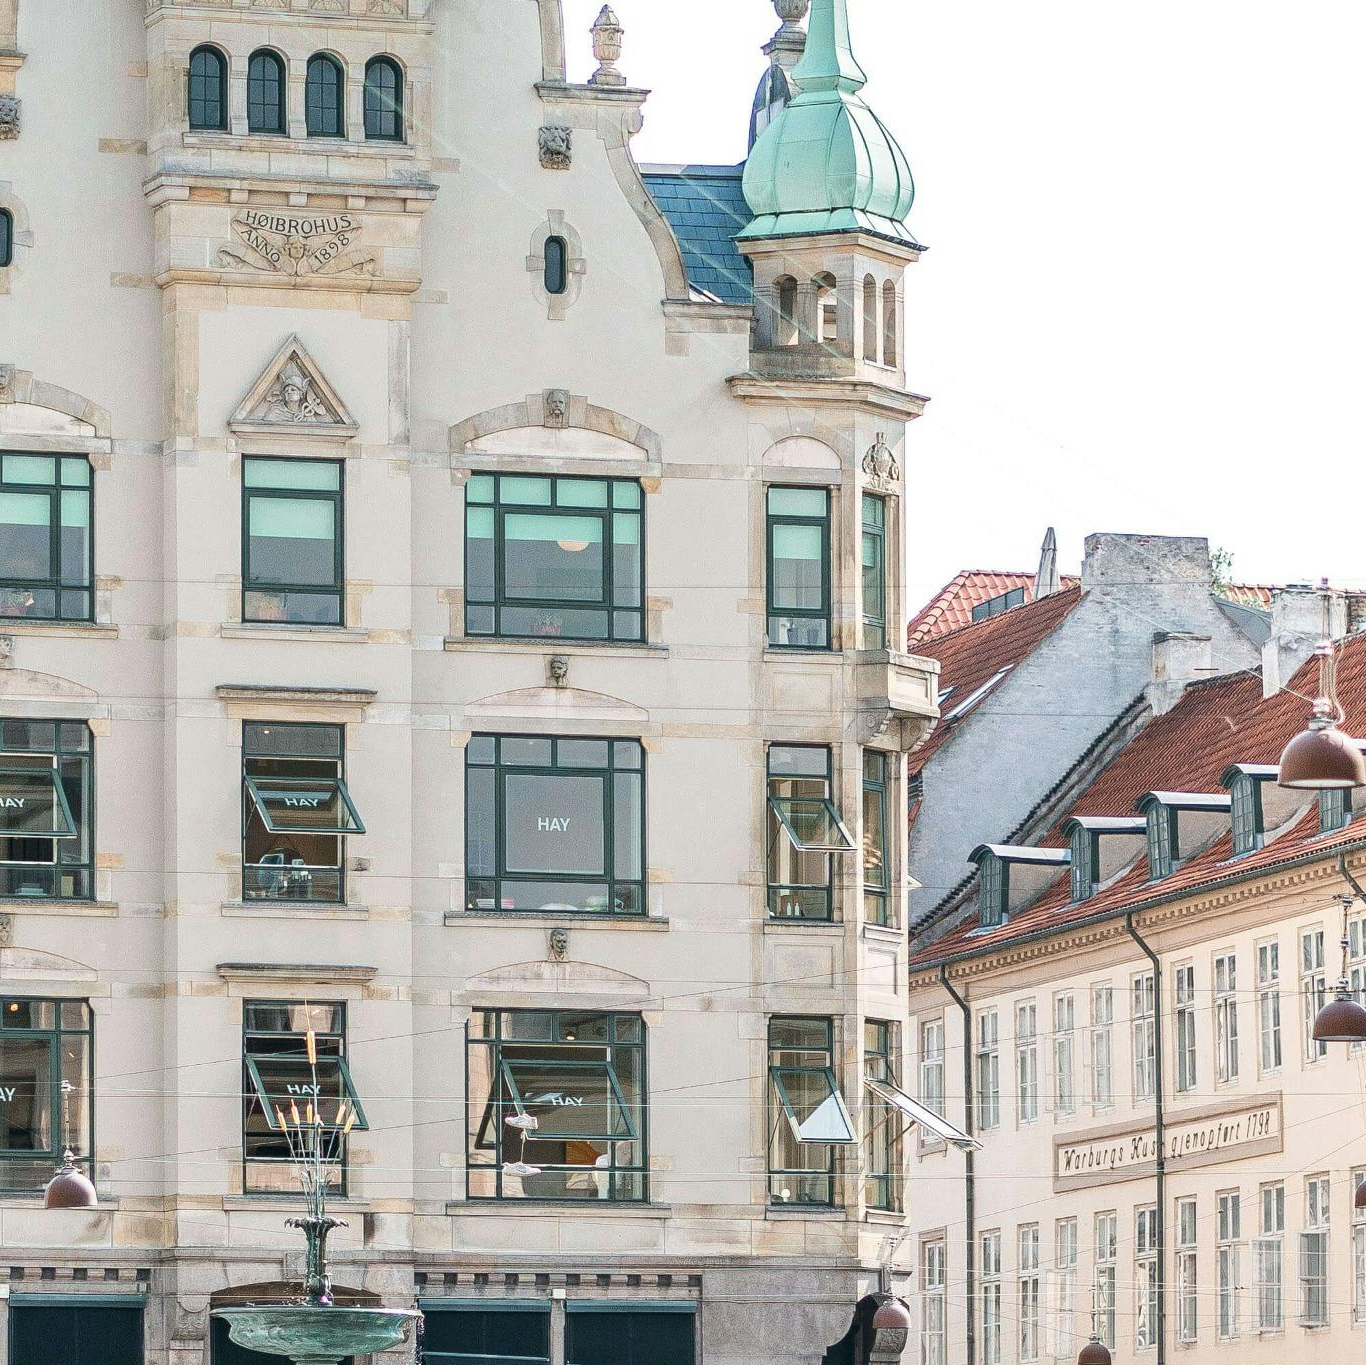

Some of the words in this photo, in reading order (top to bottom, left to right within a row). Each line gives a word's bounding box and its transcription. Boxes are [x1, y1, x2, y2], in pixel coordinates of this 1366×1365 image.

[245, 210, 352, 235] HØIBROHUS
[241, 229, 280, 263] ANNO
[314, 234, 350, 265] 1898
[284, 797, 319, 807] HAY
[538, 817, 571, 832] HAY
[287, 1084, 321, 1094] HAY
[552, 1096, 584, 1107] HAY
[1064, 1146, 1124, 1169] Warburgs
[1246, 1110, 1271, 1139] 1798
